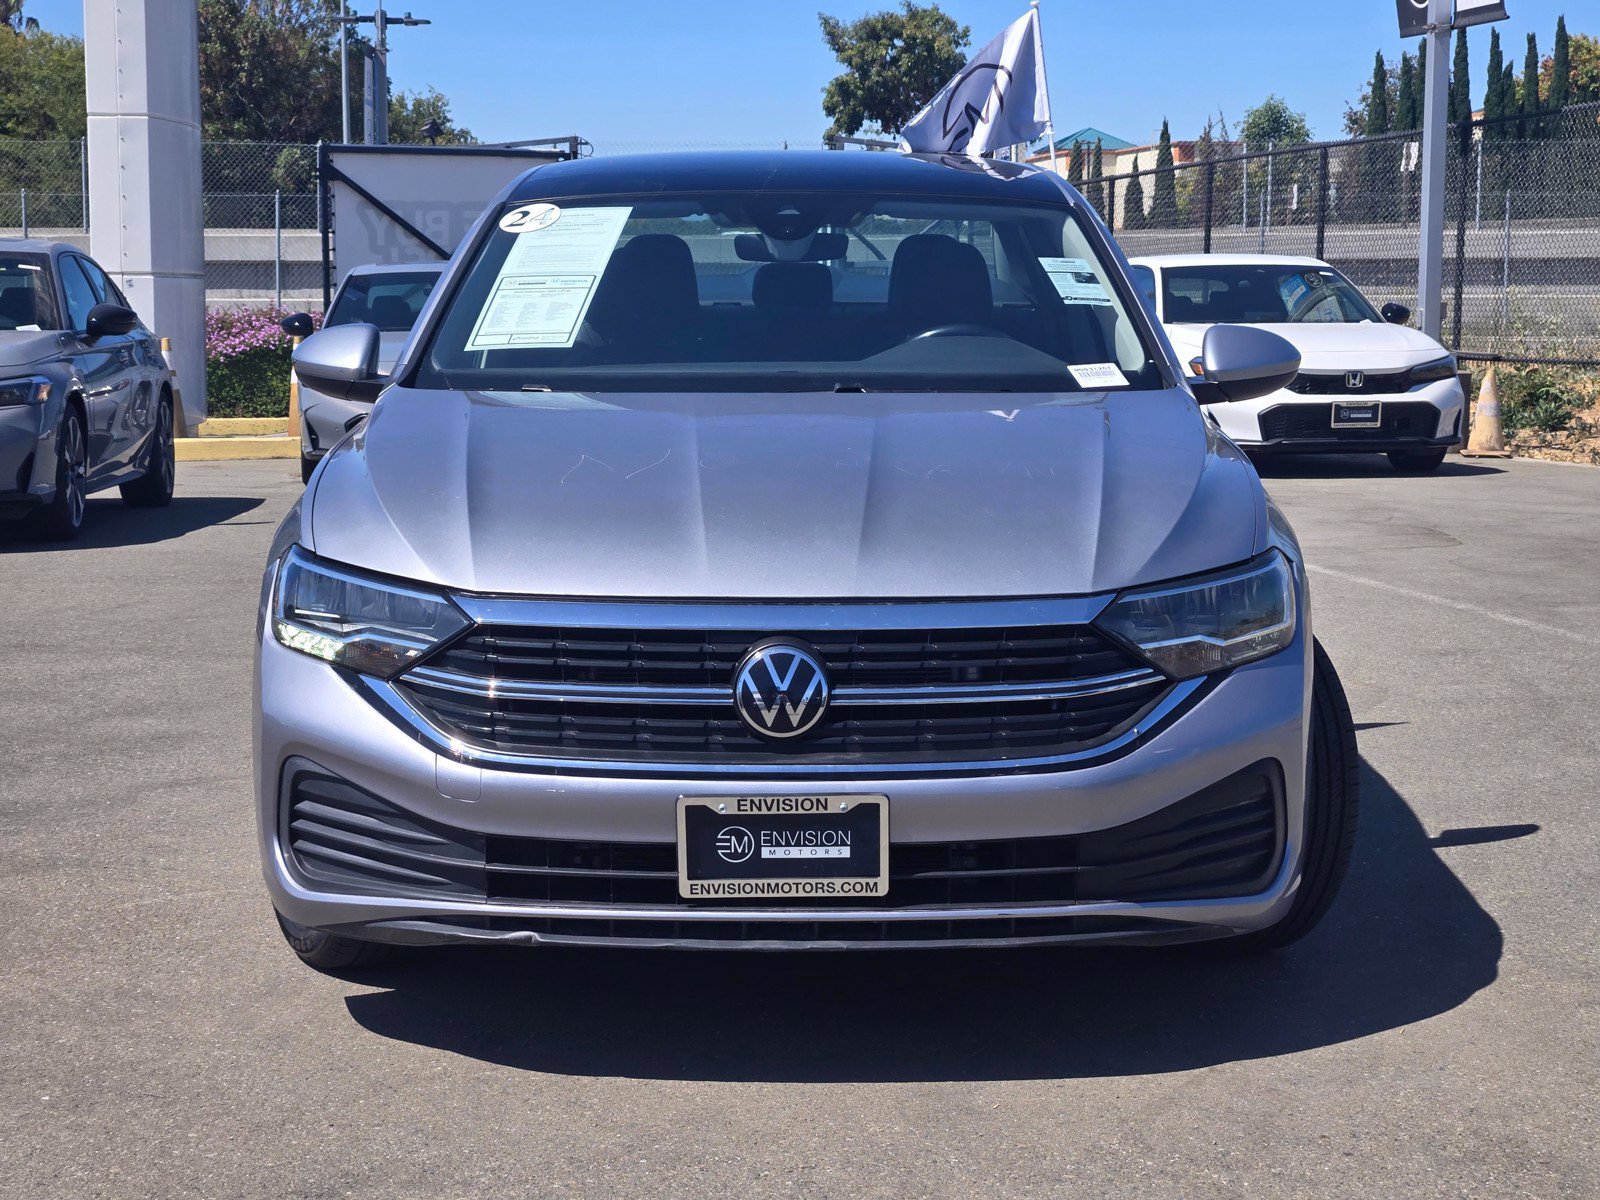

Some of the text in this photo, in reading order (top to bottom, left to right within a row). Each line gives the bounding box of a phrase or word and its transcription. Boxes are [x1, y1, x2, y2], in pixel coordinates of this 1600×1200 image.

[503, 207, 555, 228] 24
[736, 797, 828, 812] ENVISION
[760, 830, 851, 846] ENVISION
[768, 848, 843, 856] MOTORS
[689, 881, 879, 895] ENVISIONMOTORS.COM
